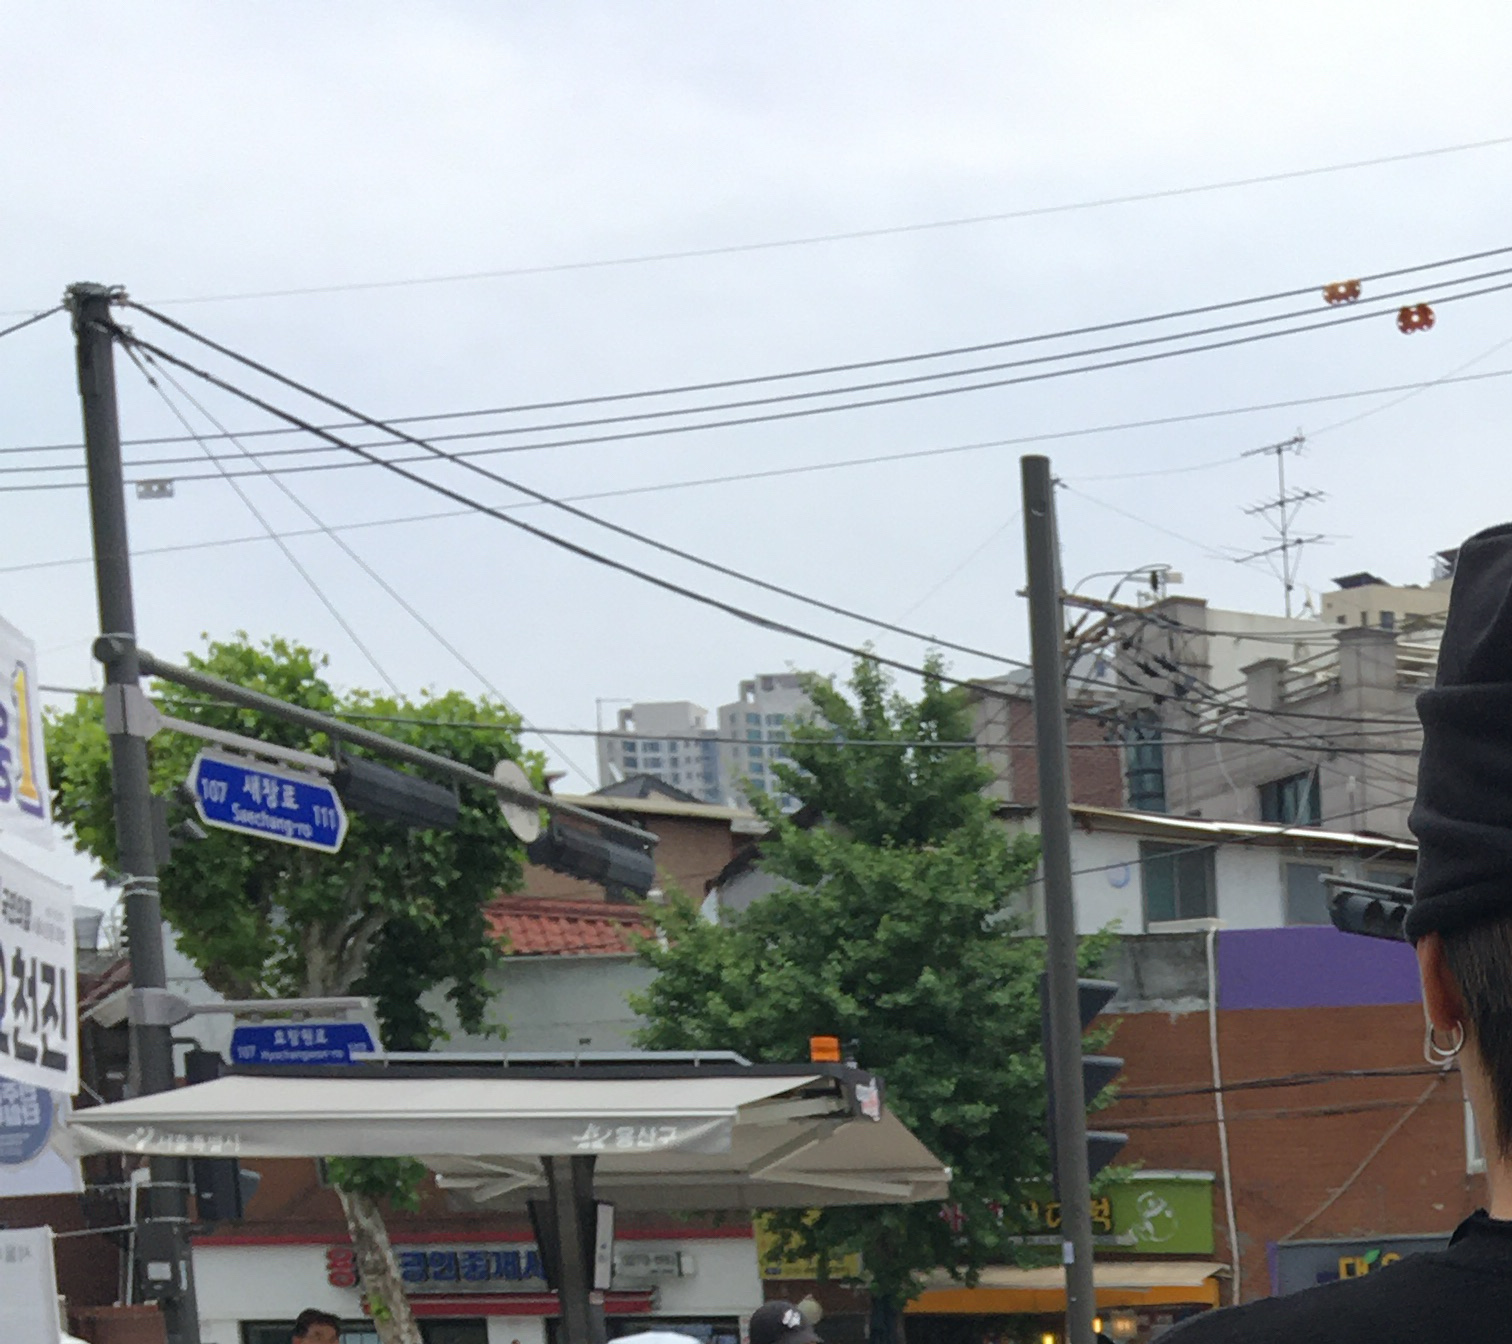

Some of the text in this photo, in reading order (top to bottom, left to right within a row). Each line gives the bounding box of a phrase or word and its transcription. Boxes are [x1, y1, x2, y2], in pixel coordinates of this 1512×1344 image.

[201, 777, 228, 803] 107
[242, 774, 300, 810] 새창로
[231, 802, 314, 839] Saechang-ro
[311, 804, 338, 831] 111
[0, 946, 68, 1072] 천진
[615, 1126, 678, 1149] 용산구
